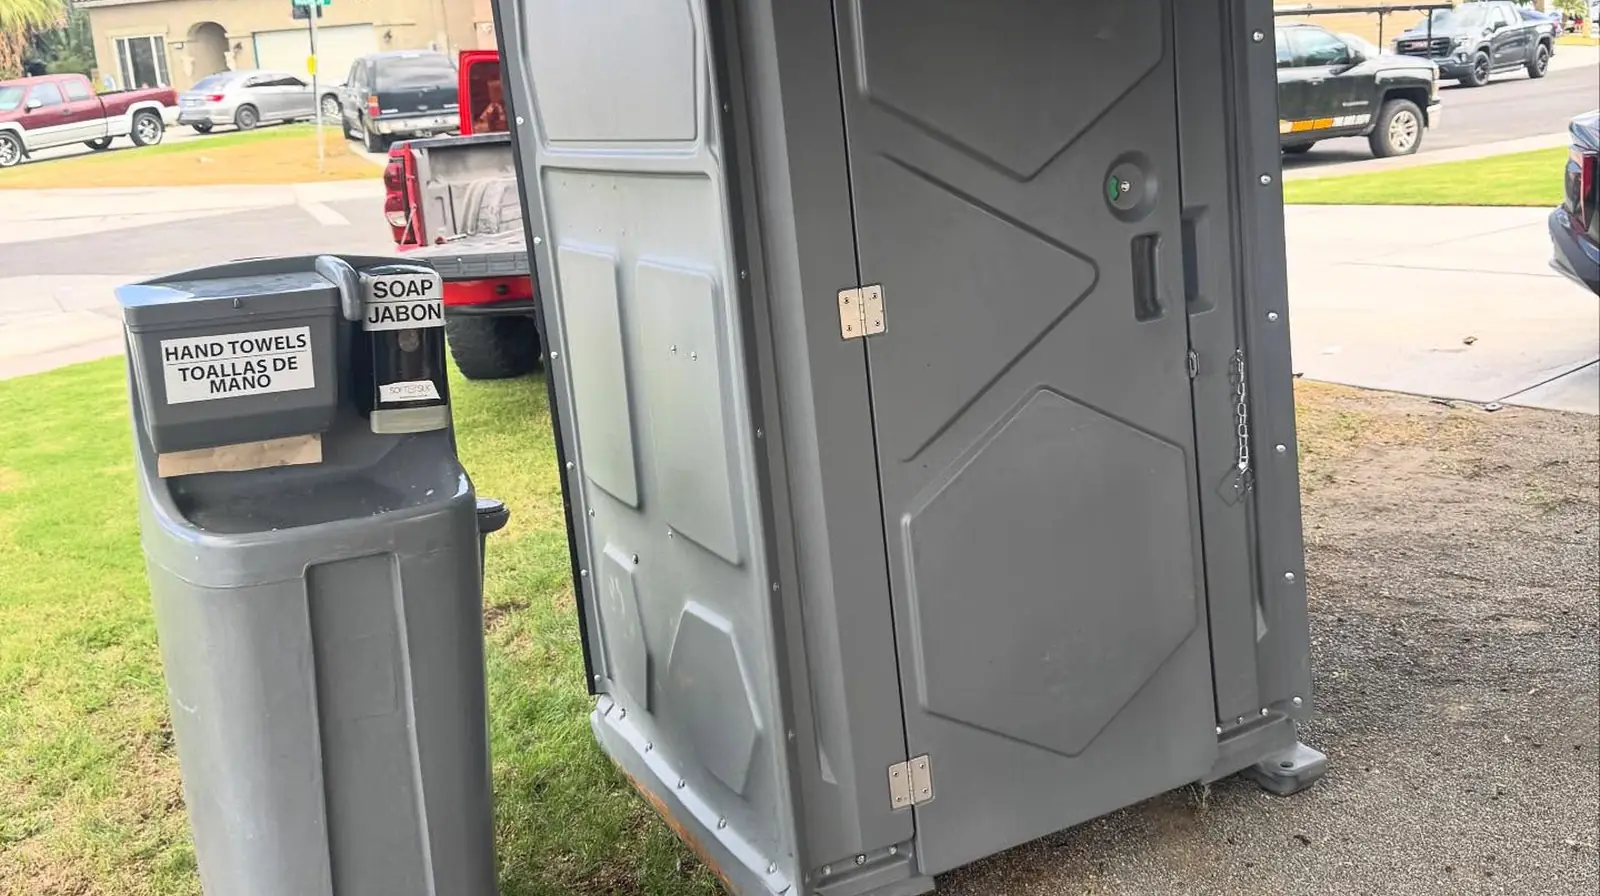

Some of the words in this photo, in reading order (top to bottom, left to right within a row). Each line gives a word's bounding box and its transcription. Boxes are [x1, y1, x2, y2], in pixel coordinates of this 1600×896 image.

[373, 279, 433, 298] SOAP
[368, 303, 442, 324] JABON
[165, 342, 224, 361] HAND
[228, 333, 306, 355] TOWELS
[178, 359, 267, 382] TOALLAS
[273, 356, 298, 372] DE
[210, 374, 271, 394] MANO
